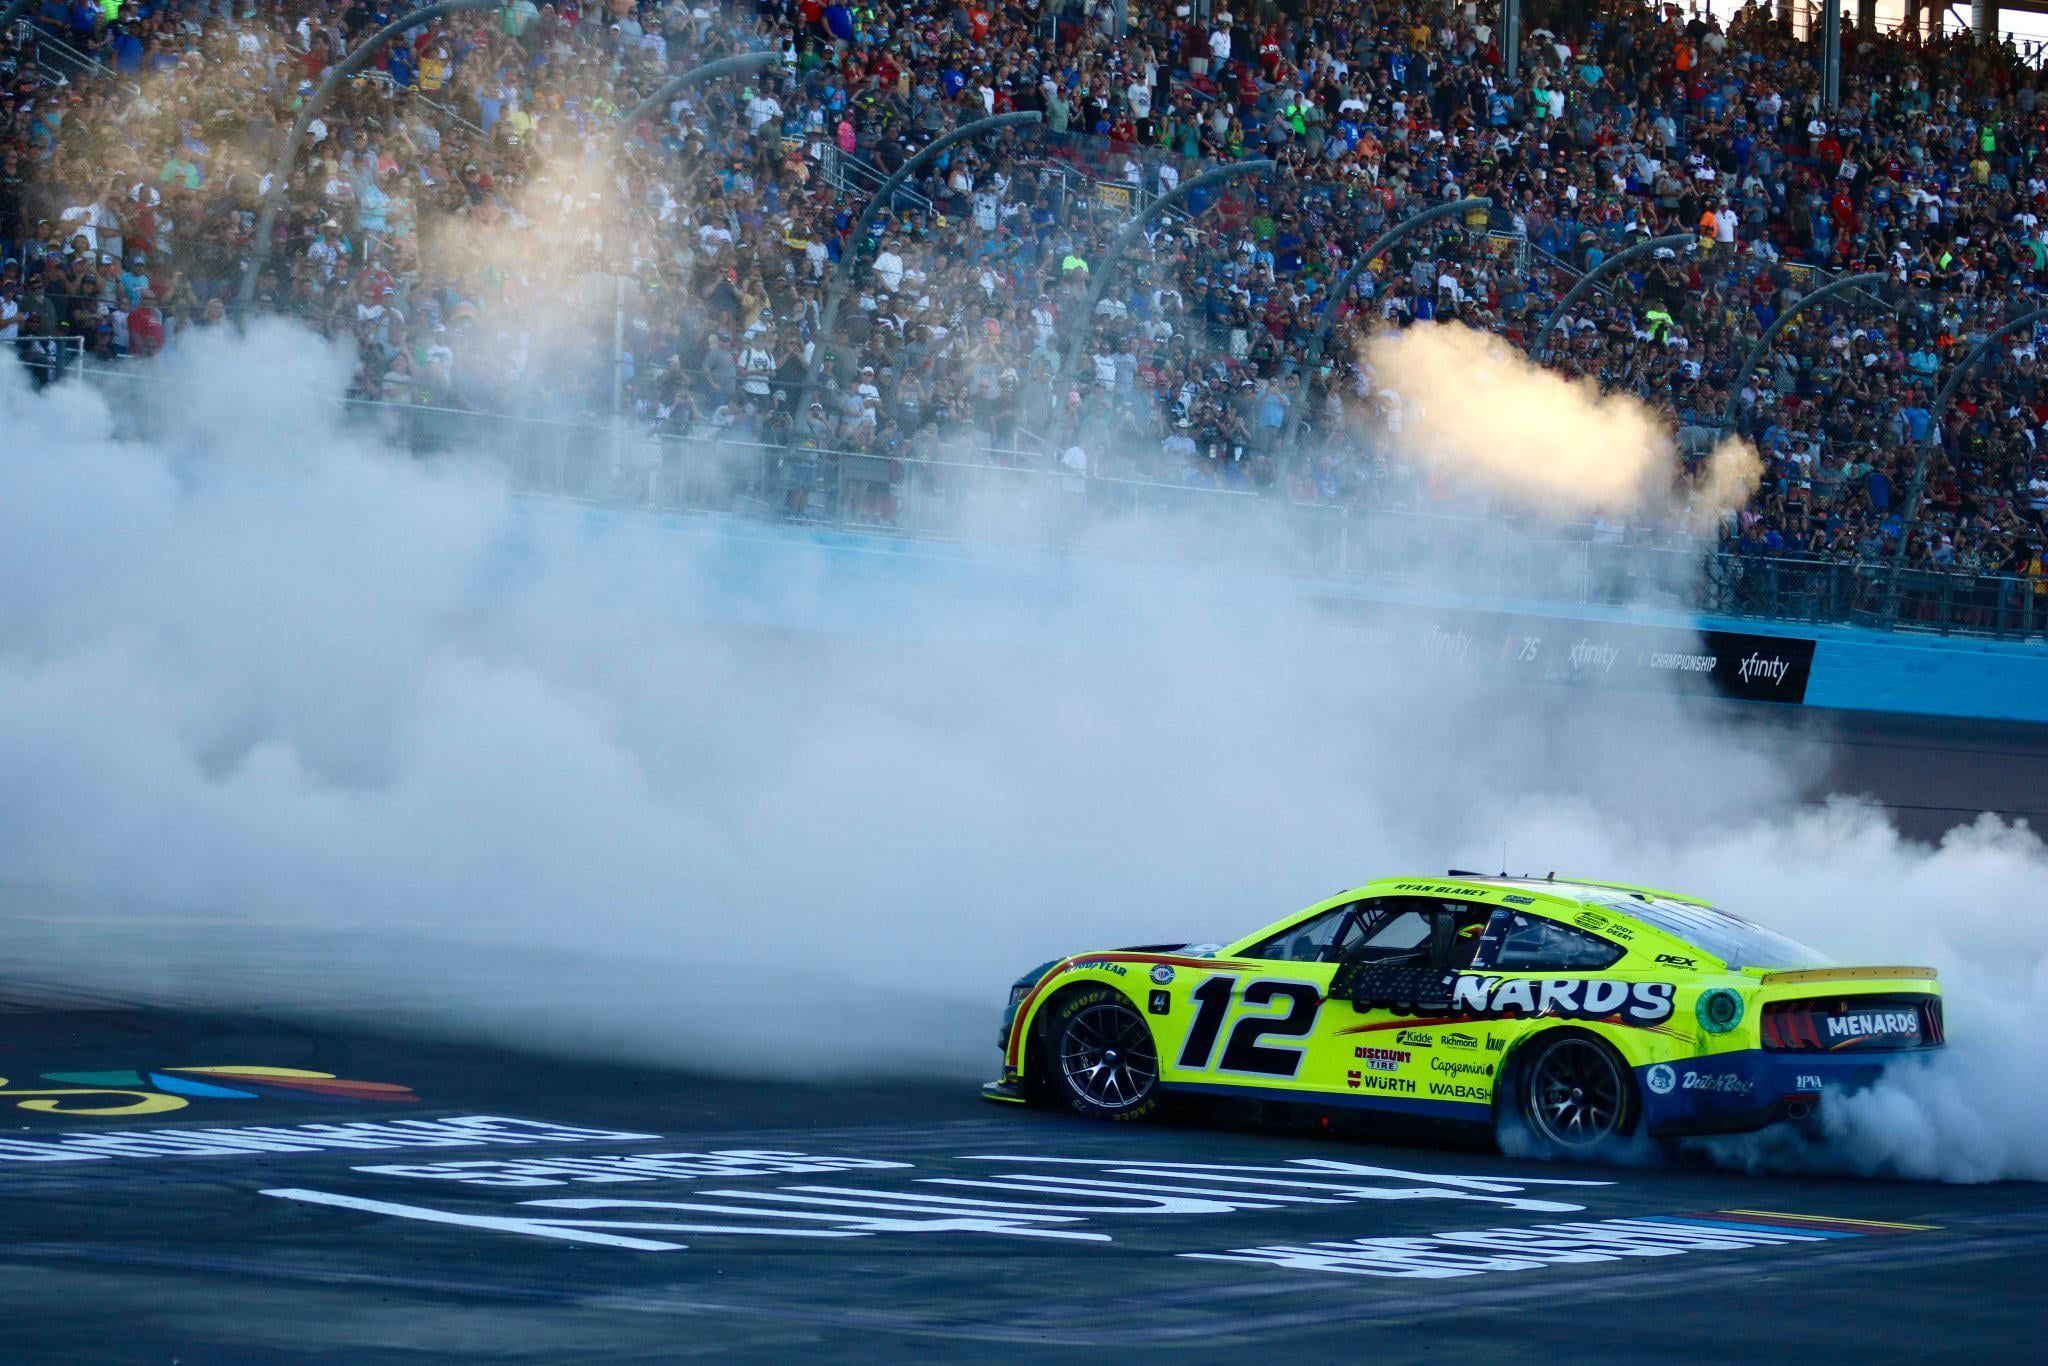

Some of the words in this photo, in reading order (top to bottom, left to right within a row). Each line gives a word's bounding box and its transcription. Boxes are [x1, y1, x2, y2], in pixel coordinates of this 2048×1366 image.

[1518, 637, 1541, 661] 75
[1568, 638, 1619, 672] xfinity
[1650, 652, 1716, 673] CHAMPIONSHIP
[1738, 652, 1790, 685] xfinity
[1394, 883, 1431, 892] RYAN
[1434, 886, 1489, 896] BLANEY
[1606, 928, 1634, 940] DEERY
[1610, 923, 1634, 934] JODY
[1654, 954, 1698, 966] DEX
[1176, 974, 1322, 1080] 12
[1827, 1014, 1917, 1037] MENARDS
[1407, 1031, 1433, 1044] Kidde
[1441, 1036, 1478, 1048] Richmond
[1354, 1046, 1411, 1063] DISCOUNT
[1370, 1060, 1395, 1070] TIRE
[1431, 1057, 1486, 1078] Capgemini
[1682, 1071, 1724, 1092] Dutch
[1429, 1083, 1493, 1100] WABASH
